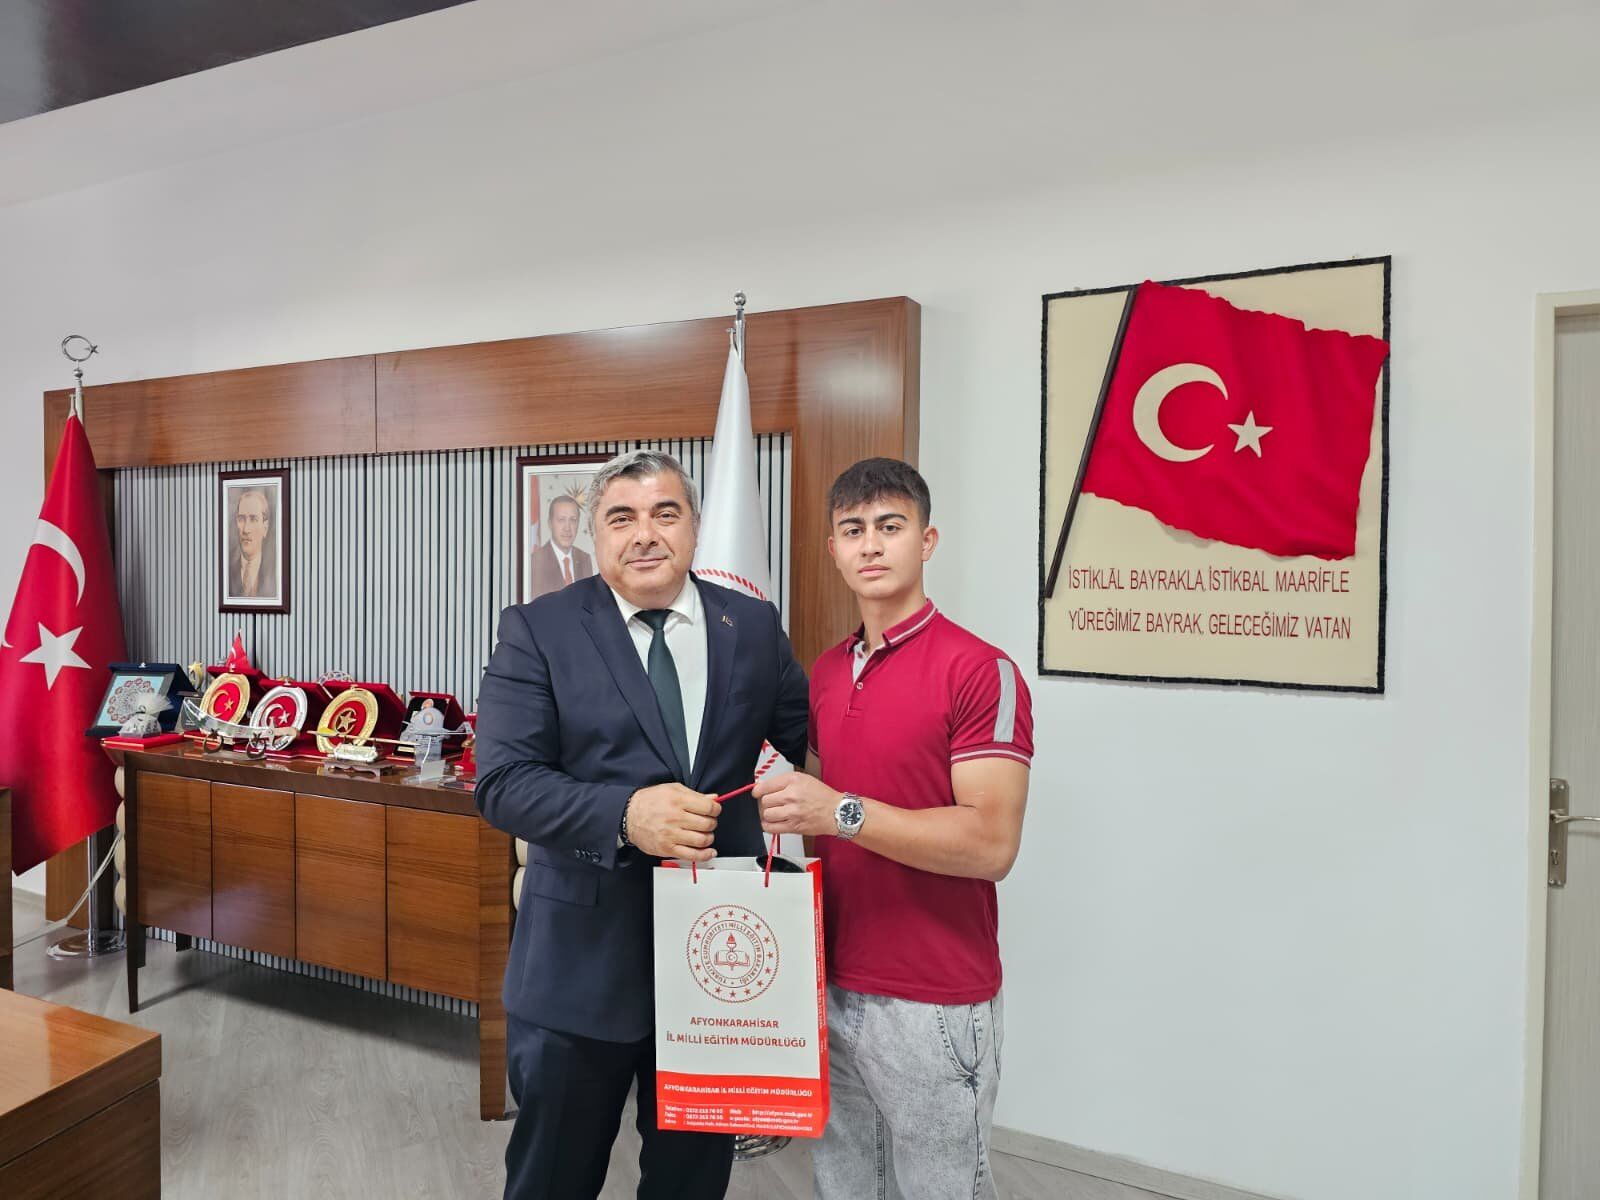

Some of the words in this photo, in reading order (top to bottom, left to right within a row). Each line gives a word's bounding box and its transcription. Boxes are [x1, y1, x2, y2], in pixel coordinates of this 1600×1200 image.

[1209, 566, 1269, 592] İSTİKBAL
[1275, 567, 1350, 593] MAARİFLE
[1068, 607, 1140, 632] YÜREĞİMİZ
[1208, 611, 1299, 637] GELECEĞİMİZ
[1304, 616, 1351, 640] VATAN
[690, 1016, 779, 1028] AFYONKARAHİSAR
[666, 1030, 675, 1042] İL
[676, 1032, 702, 1044] MİLLİ
[704, 1034, 738, 1045] EĞİTİM
[741, 1035, 806, 1048] MÜDÜRLÜĞÜ
